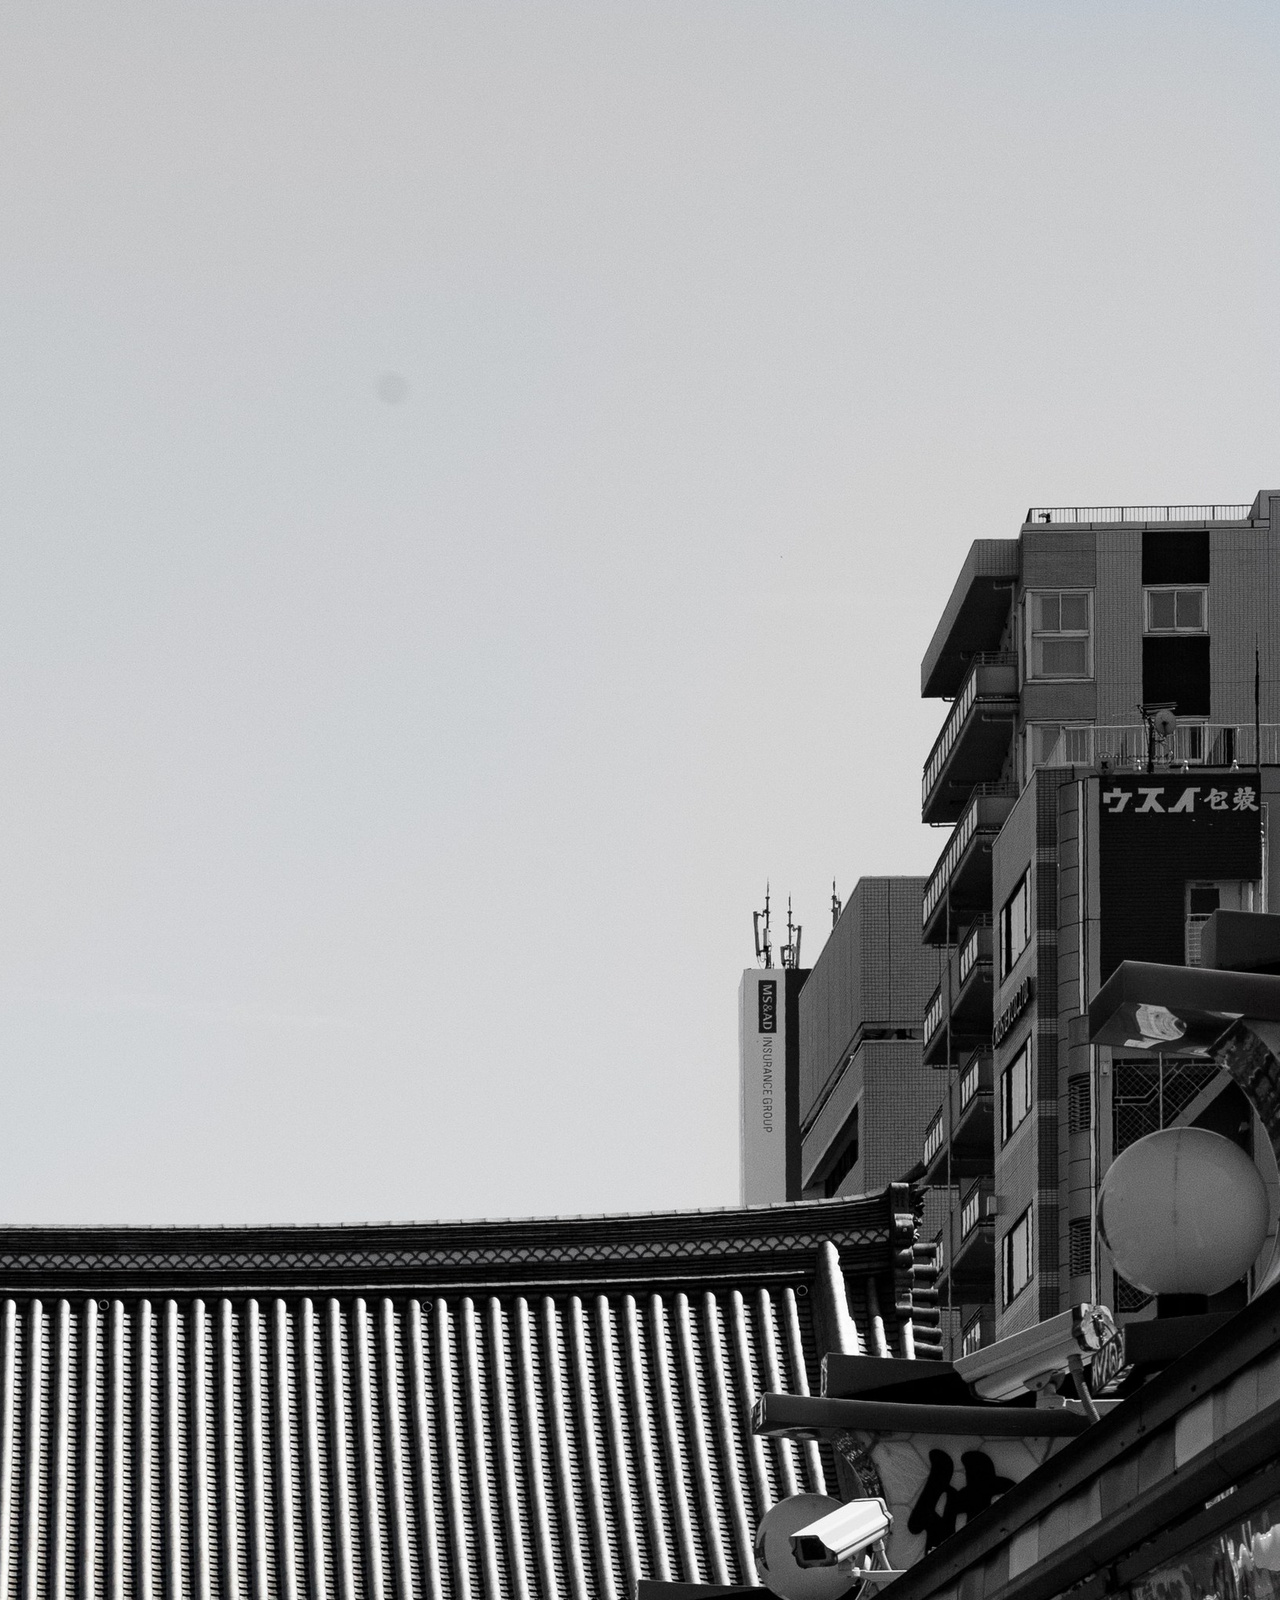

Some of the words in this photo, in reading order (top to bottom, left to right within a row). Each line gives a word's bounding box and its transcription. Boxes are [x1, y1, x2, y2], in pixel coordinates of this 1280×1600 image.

[762, 984, 773, 1030] MS&AD
[762, 1036, 773, 1096] INSURANCE
[762, 1097, 773, 1134] GROUP
